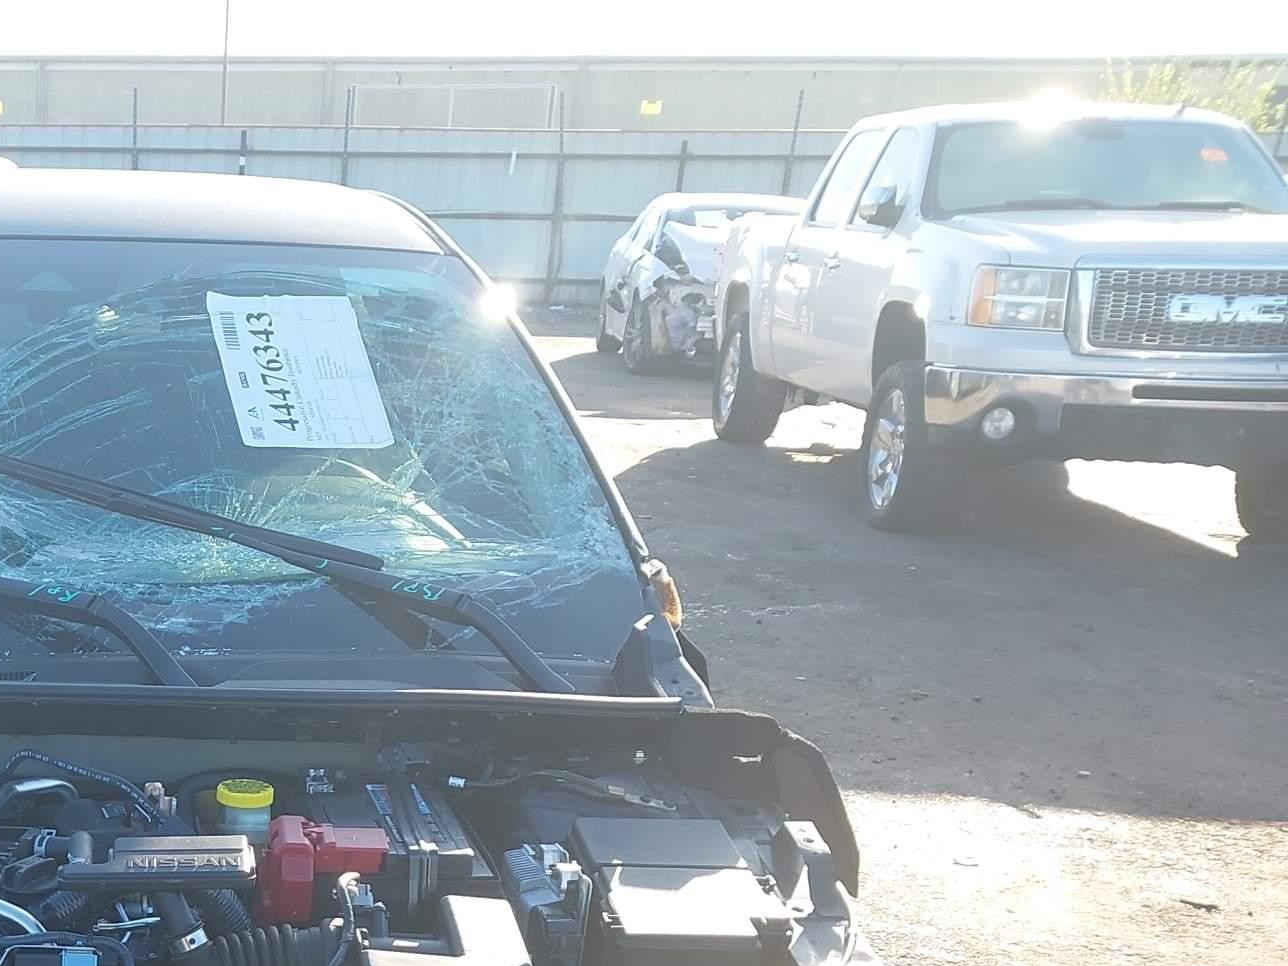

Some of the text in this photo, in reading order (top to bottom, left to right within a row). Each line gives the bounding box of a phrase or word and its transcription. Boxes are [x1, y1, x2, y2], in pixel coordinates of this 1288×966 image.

[1168, 295, 1287, 322] GMC
[246, 312, 300, 432] 44476343
[128, 856, 241, 868] NISSAN
